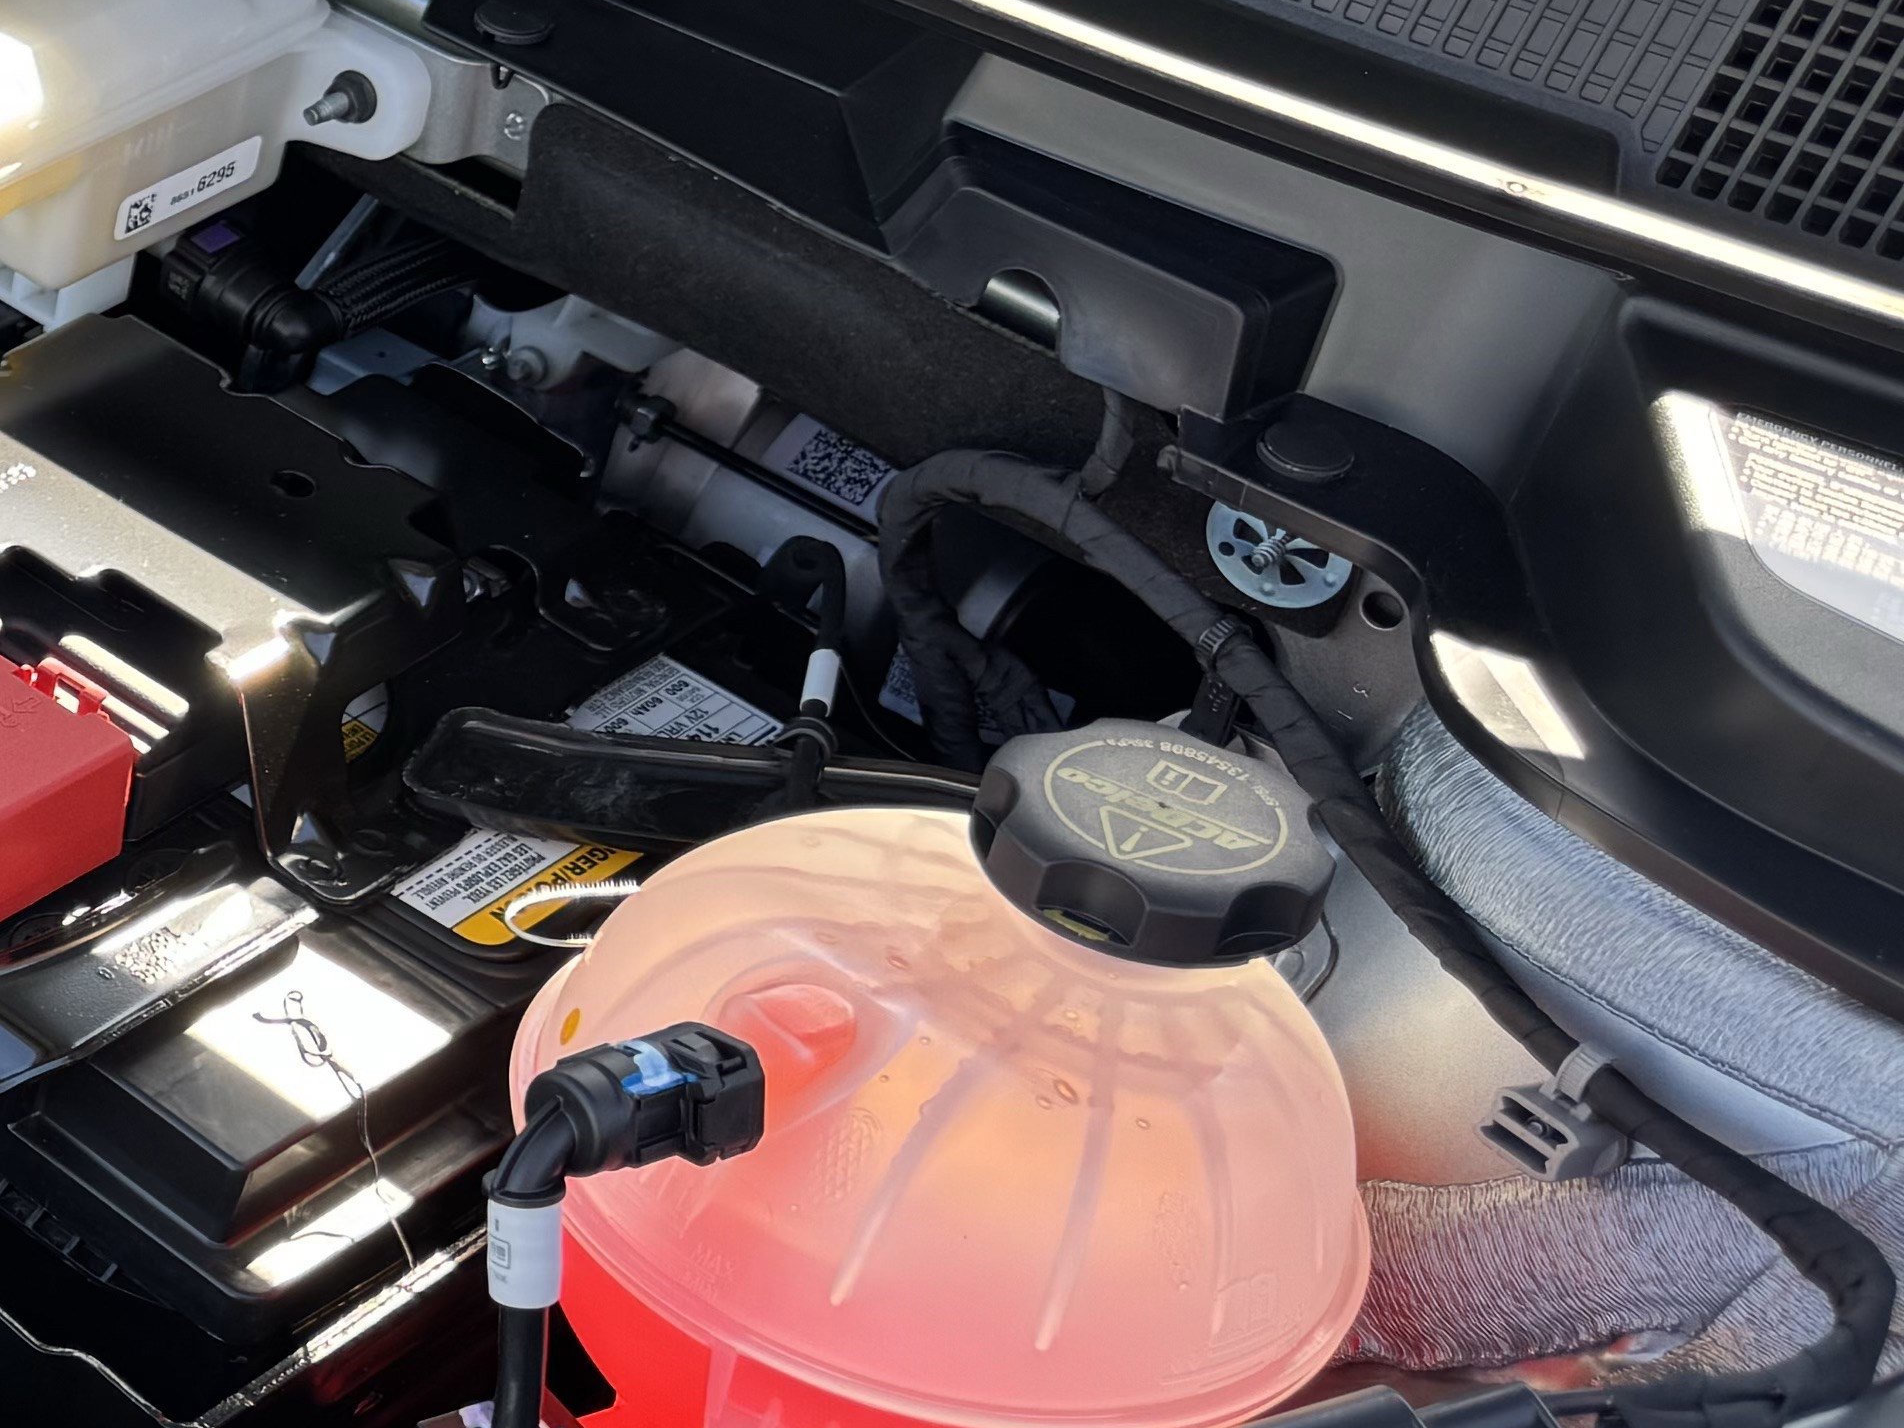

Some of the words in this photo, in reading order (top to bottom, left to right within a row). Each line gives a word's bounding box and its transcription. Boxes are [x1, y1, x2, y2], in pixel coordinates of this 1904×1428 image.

[196, 160, 237, 193] 6295
[511, 842, 532, 857] LES
[483, 876, 506, 891] LES
